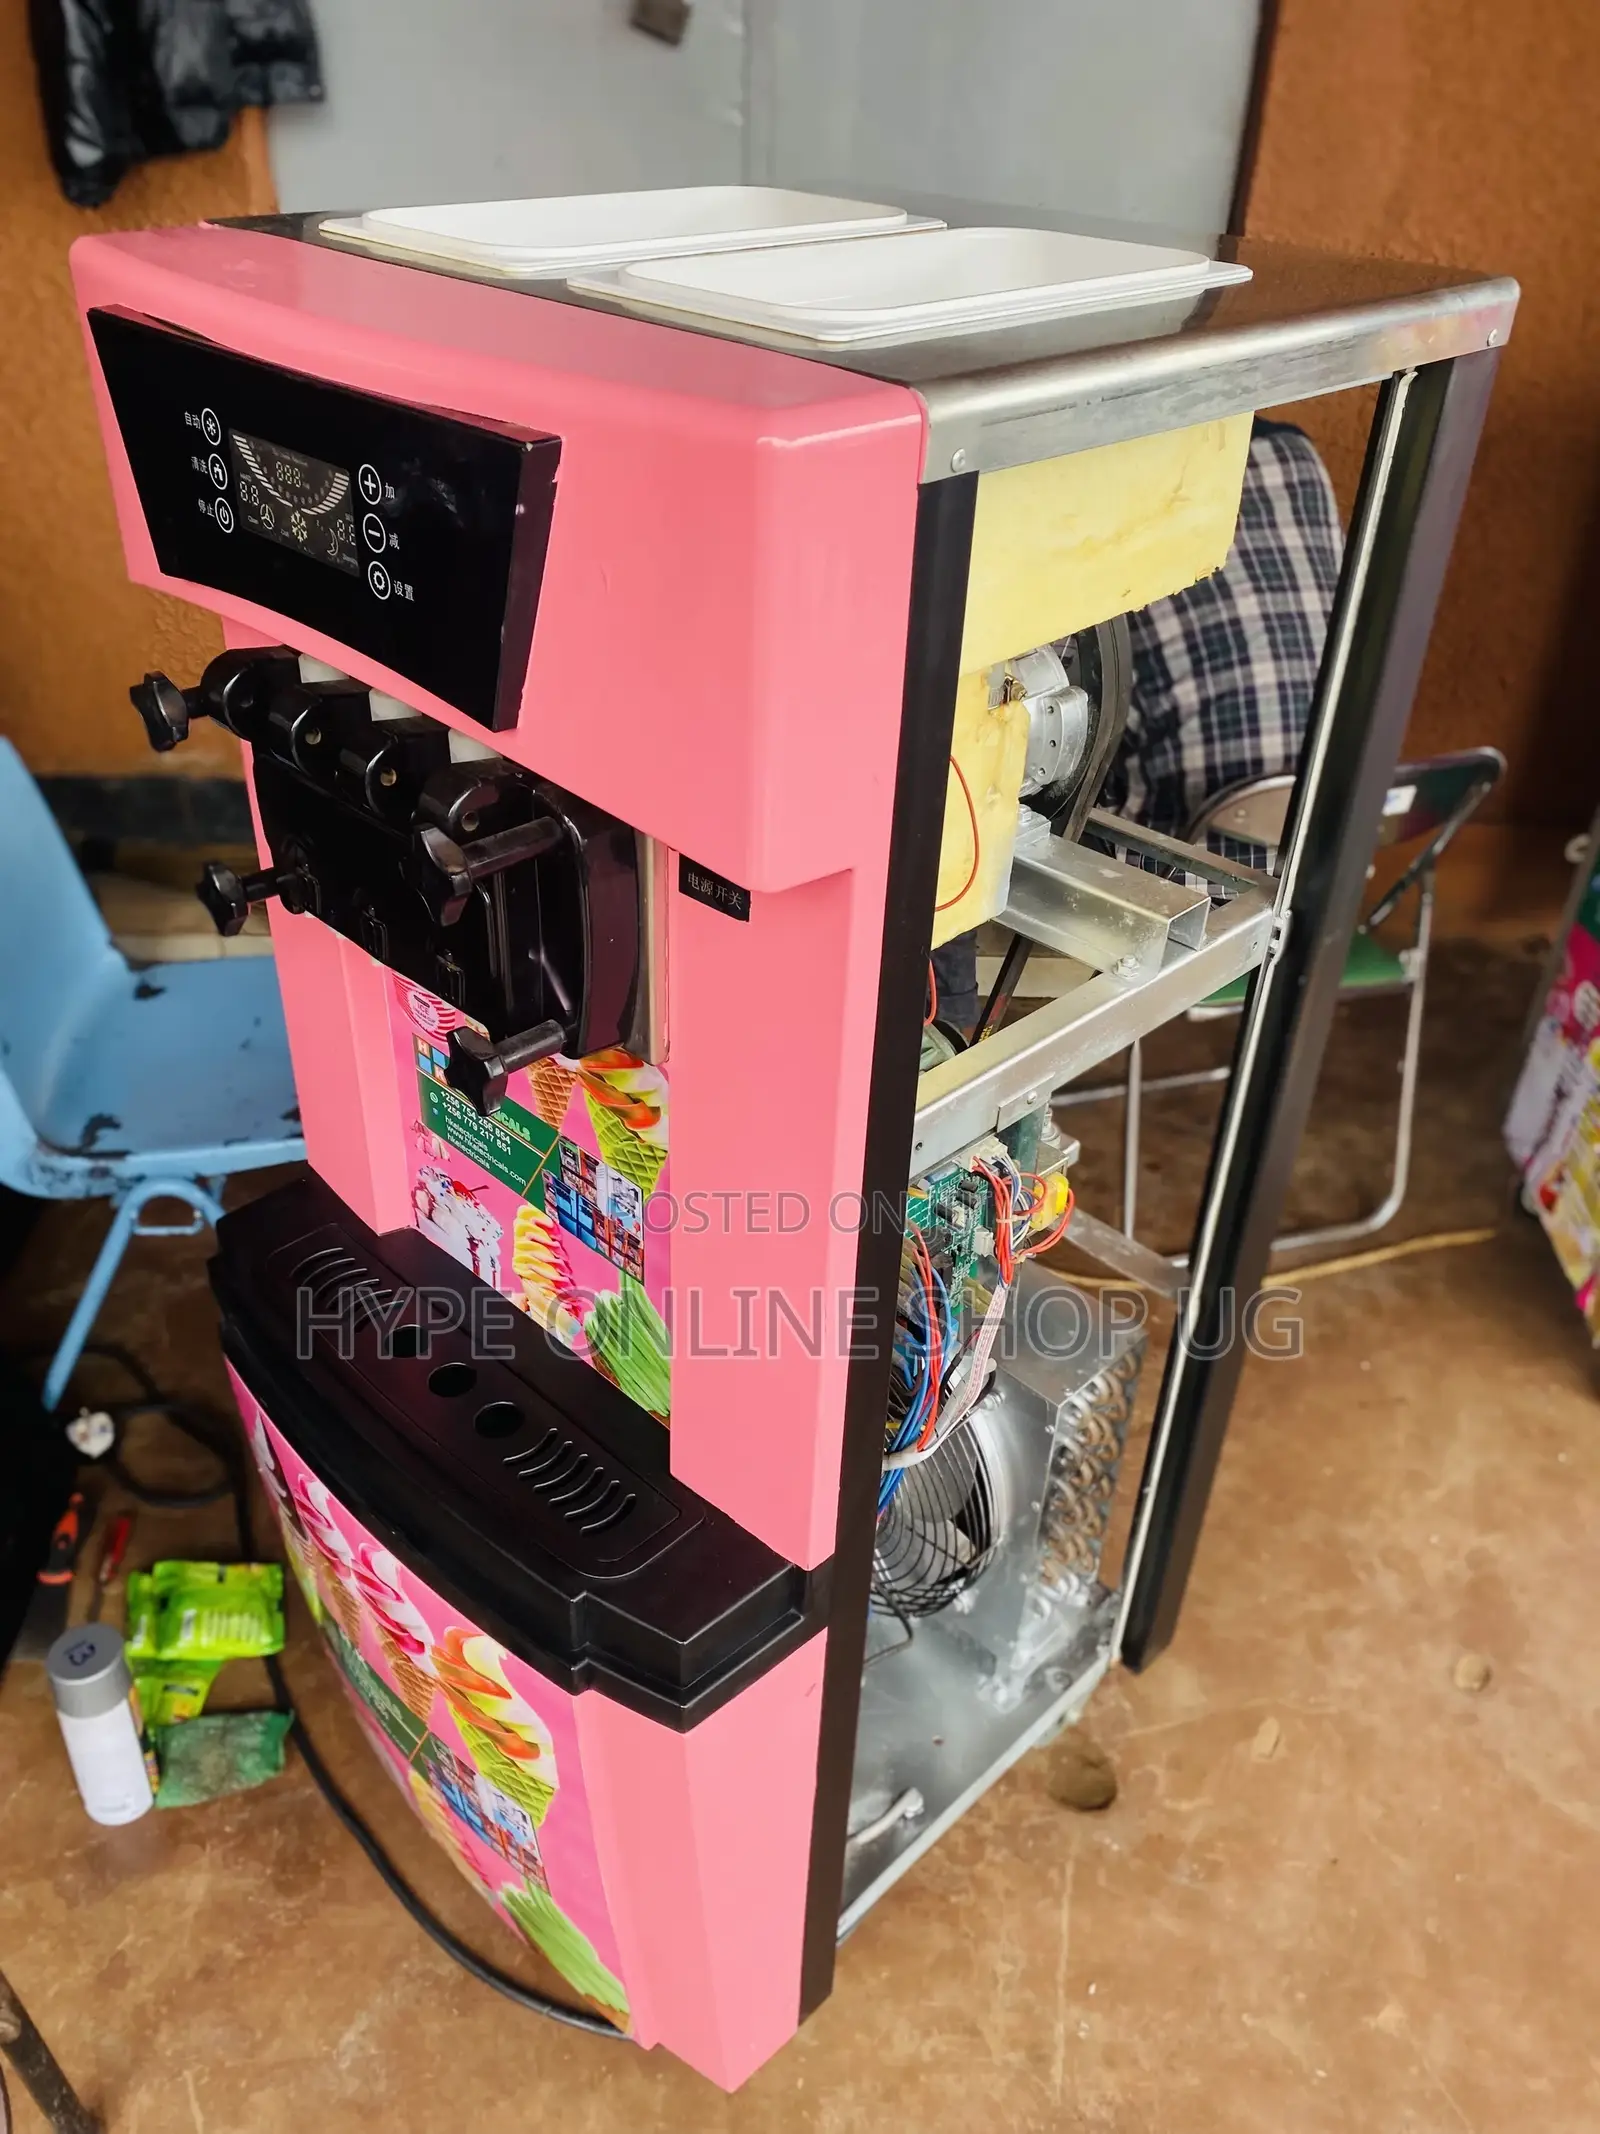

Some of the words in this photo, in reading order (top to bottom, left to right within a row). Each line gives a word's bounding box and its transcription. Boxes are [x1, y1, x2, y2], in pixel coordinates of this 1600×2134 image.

[385, 482, 395, 499] 加
[393, 580, 414, 601] 设置
[687, 871, 742, 910] 电源开关
[480, 1127, 495, 1142] 217
